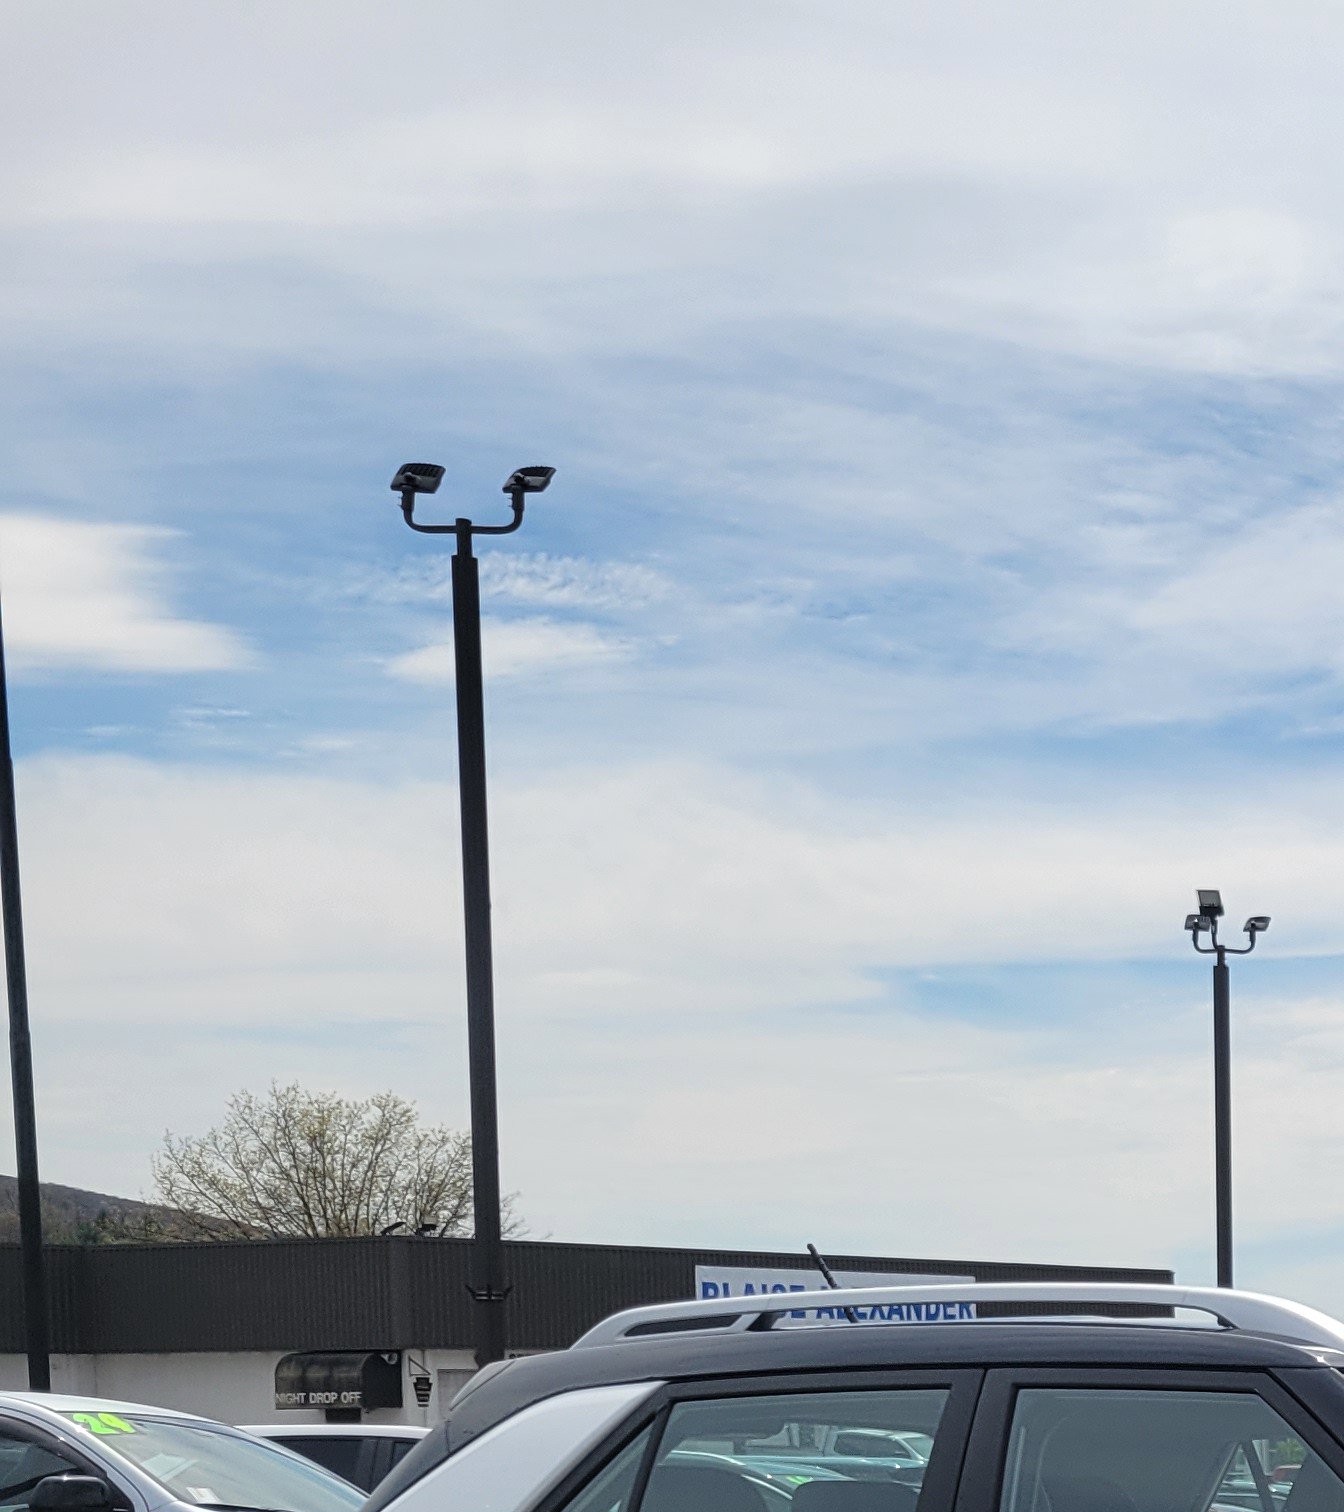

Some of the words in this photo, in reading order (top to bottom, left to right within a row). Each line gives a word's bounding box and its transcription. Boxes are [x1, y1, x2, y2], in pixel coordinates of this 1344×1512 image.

[276, 1392, 307, 1405] NIGHT
[309, 1392, 338, 1404] DROP
[341, 1391, 362, 1404] OFF
